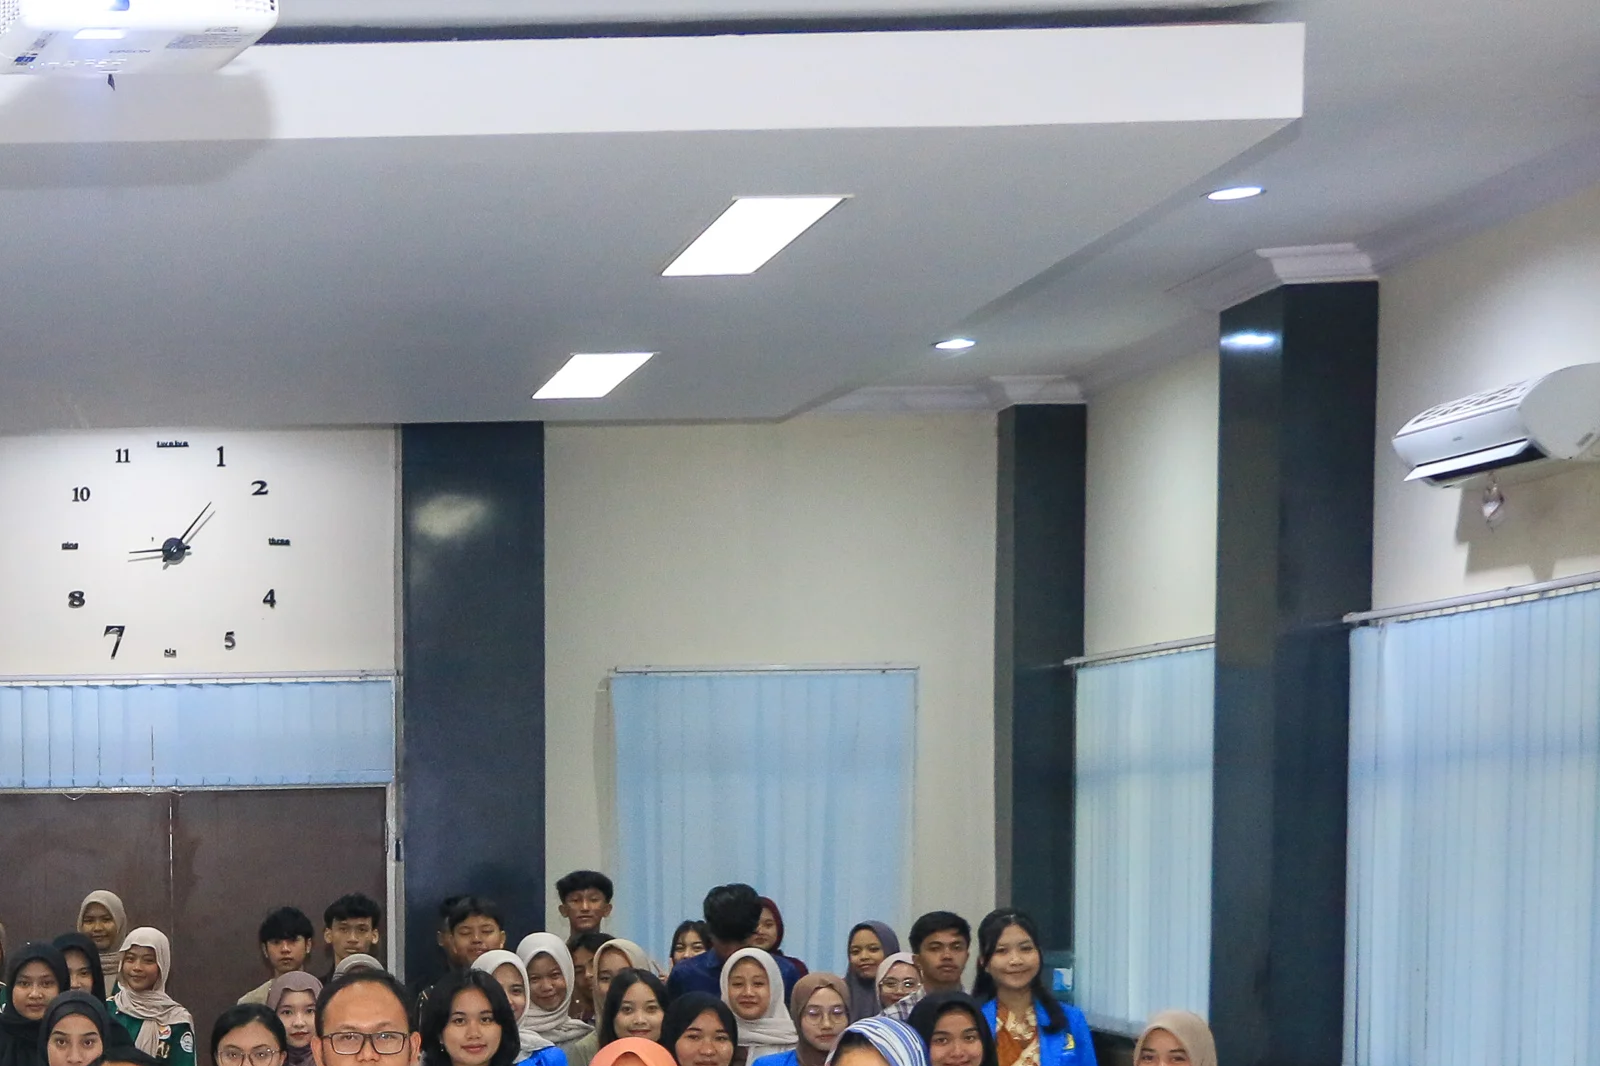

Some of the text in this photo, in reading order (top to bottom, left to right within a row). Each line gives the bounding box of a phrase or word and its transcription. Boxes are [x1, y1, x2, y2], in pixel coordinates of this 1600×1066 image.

[156, 440, 189, 448] twelve
[115, 449, 131, 464] 11
[216, 446, 226, 467] 1
[72, 487, 91, 502] 10
[251, 480, 269, 496] 2
[268, 537, 291, 546] three
[67, 590, 86, 609] 8
[262, 588, 276, 608] 4
[103, 625, 126, 659] 7
[224, 631, 236, 650] 5
